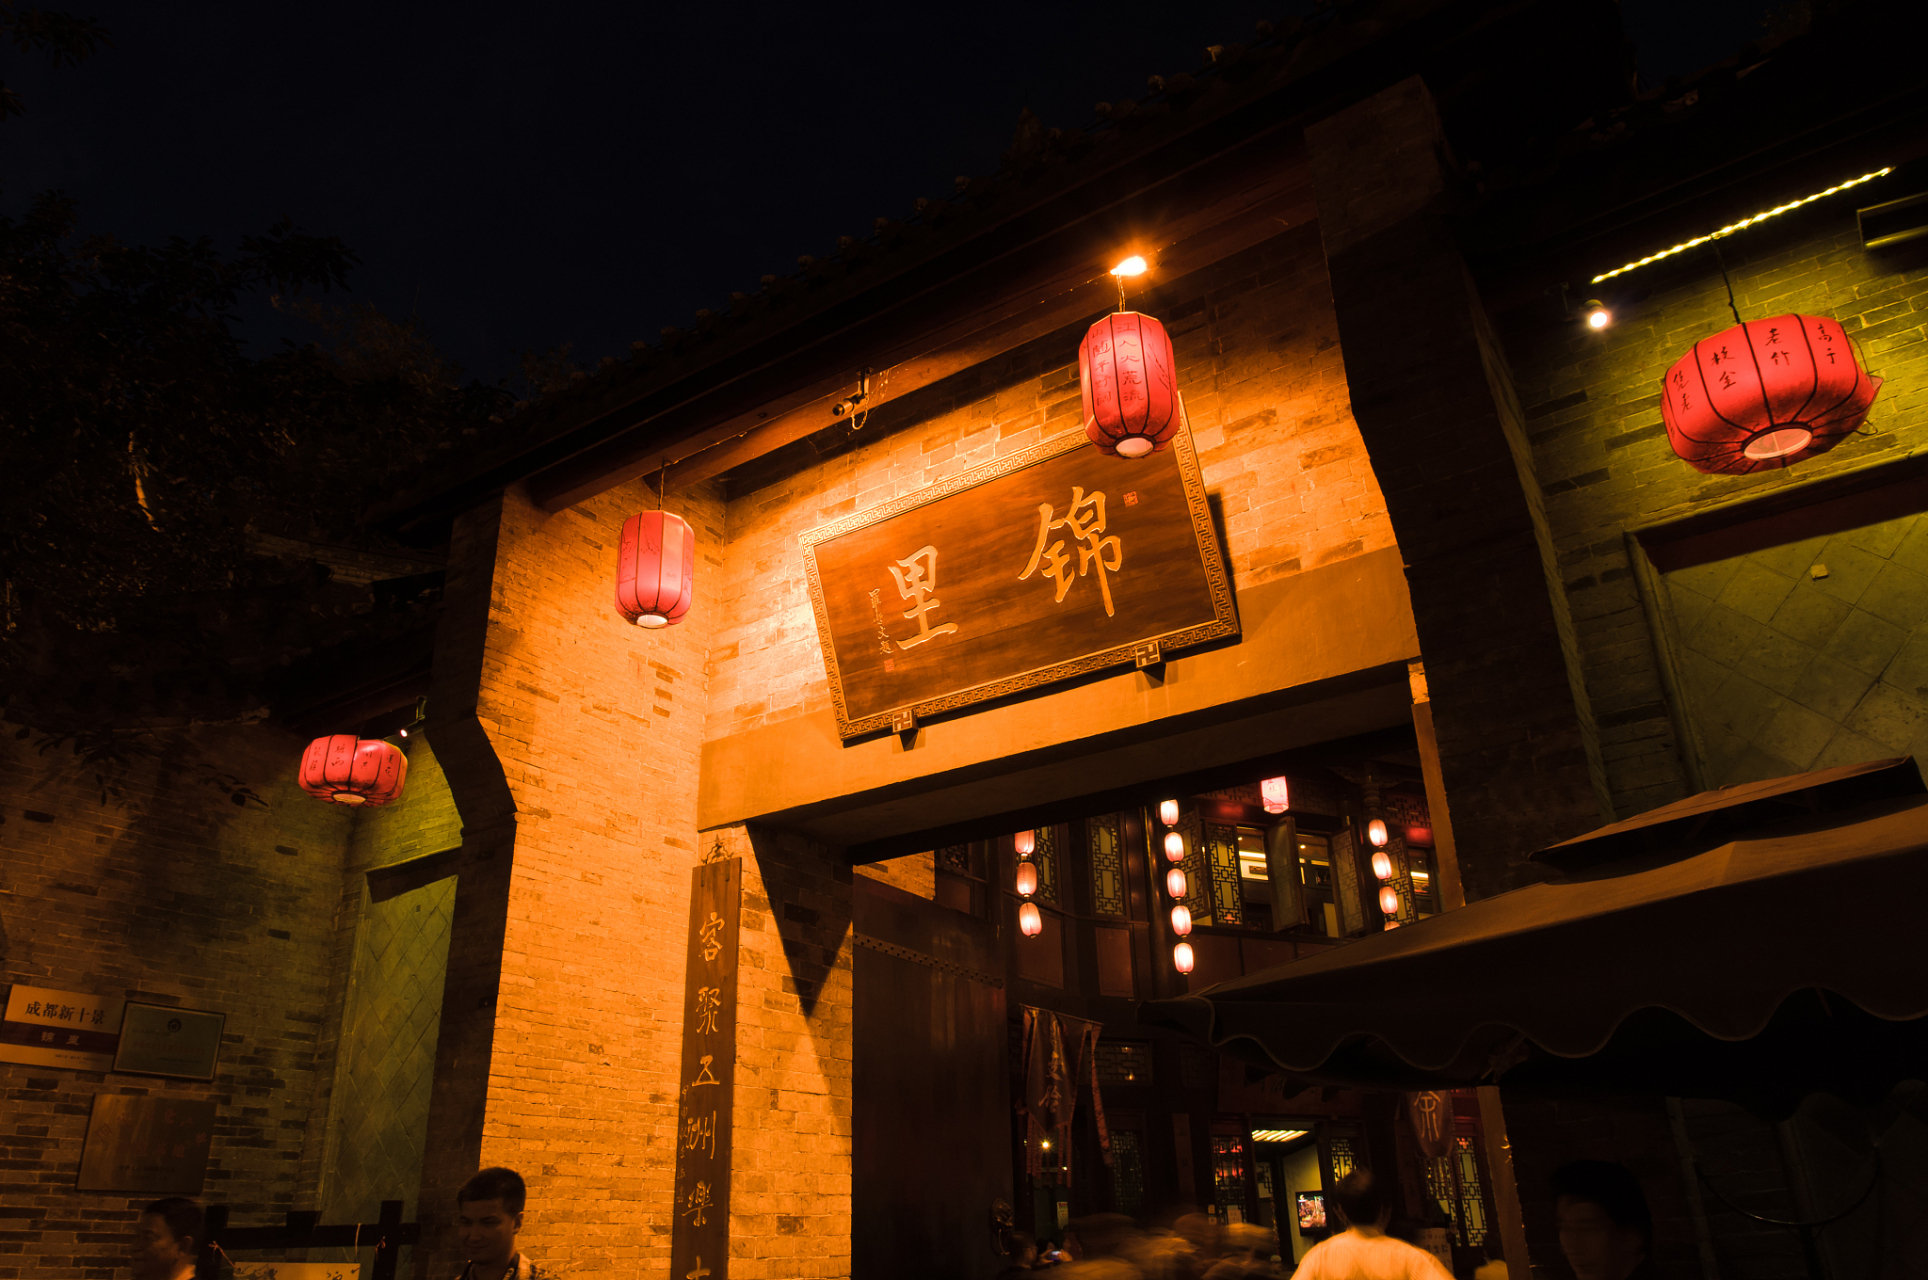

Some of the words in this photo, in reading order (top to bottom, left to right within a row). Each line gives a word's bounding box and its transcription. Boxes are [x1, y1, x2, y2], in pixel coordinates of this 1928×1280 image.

[25, 1000, 106, 1025] 成都新十景
